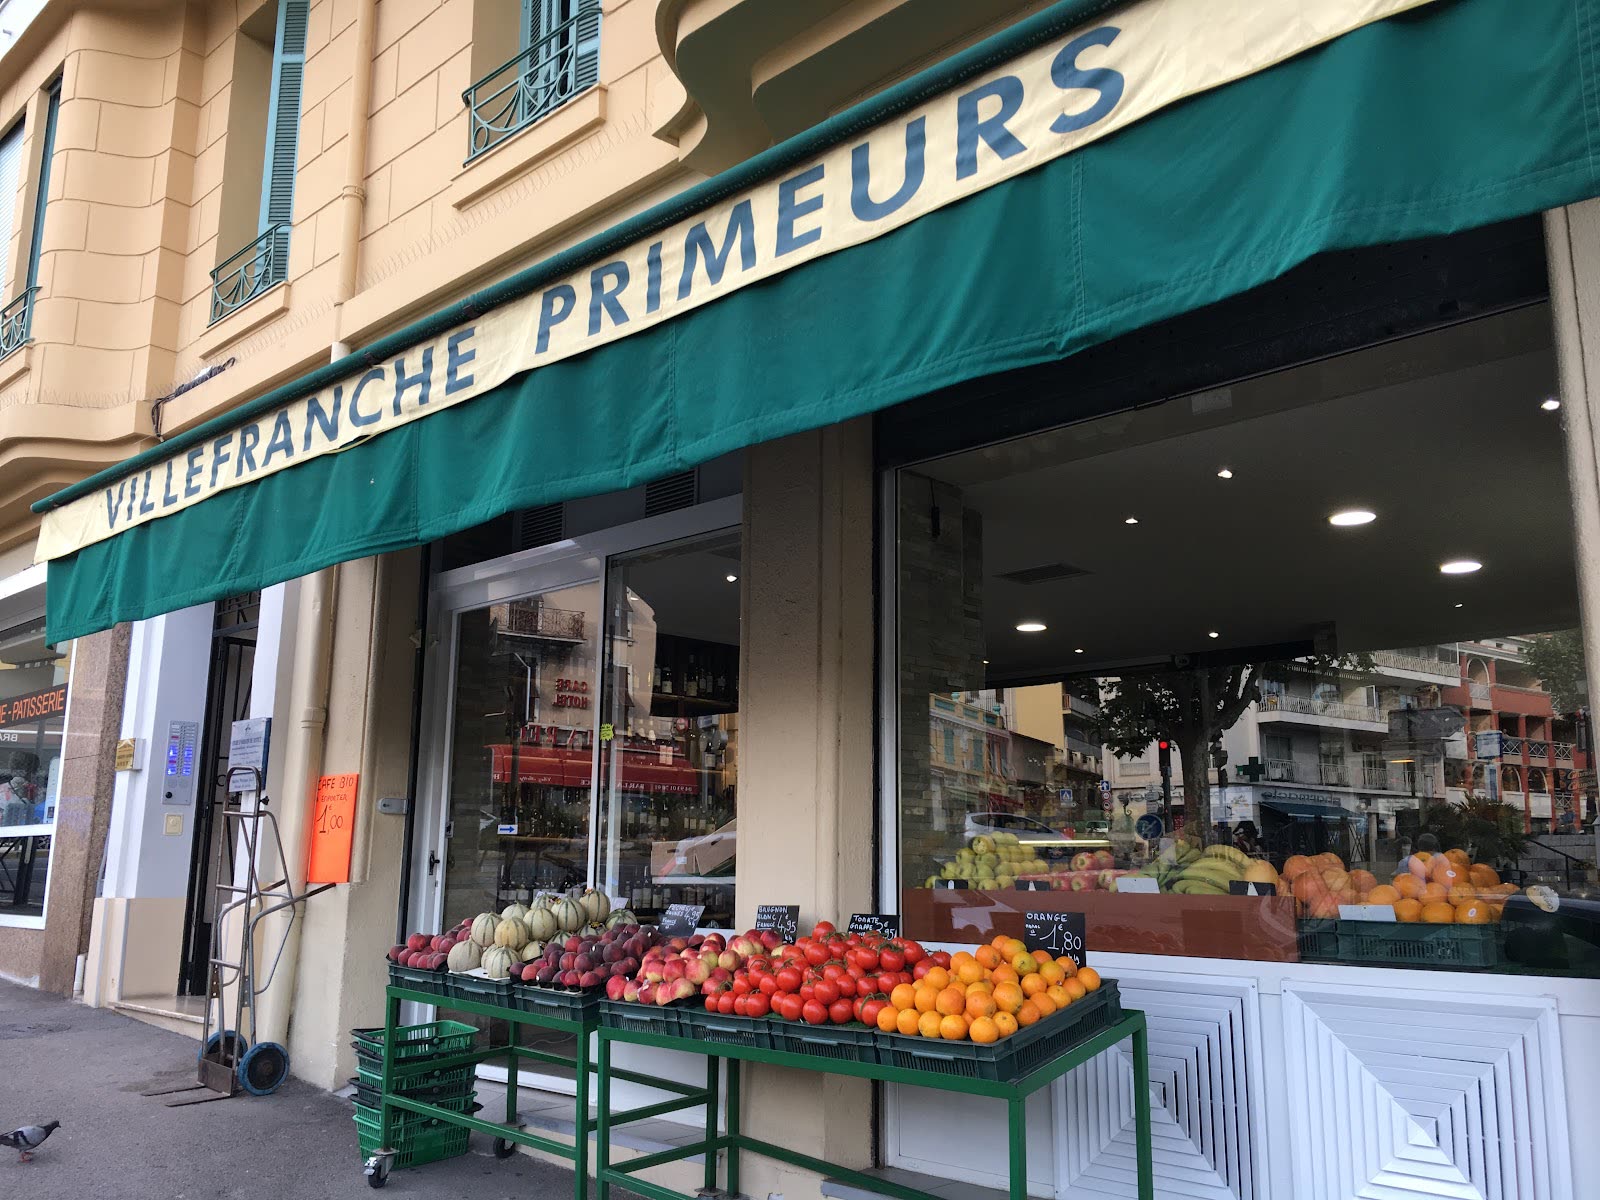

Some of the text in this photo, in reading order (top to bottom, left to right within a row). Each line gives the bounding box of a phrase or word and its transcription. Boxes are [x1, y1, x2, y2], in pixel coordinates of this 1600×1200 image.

[106, 26, 1125, 529] VILLEFRANCHE PRIMEURS
[340, 776, 354, 789] BIO
[853, 914, 880, 924] TOMATE
[1026, 912, 1068, 922] ORANGE
